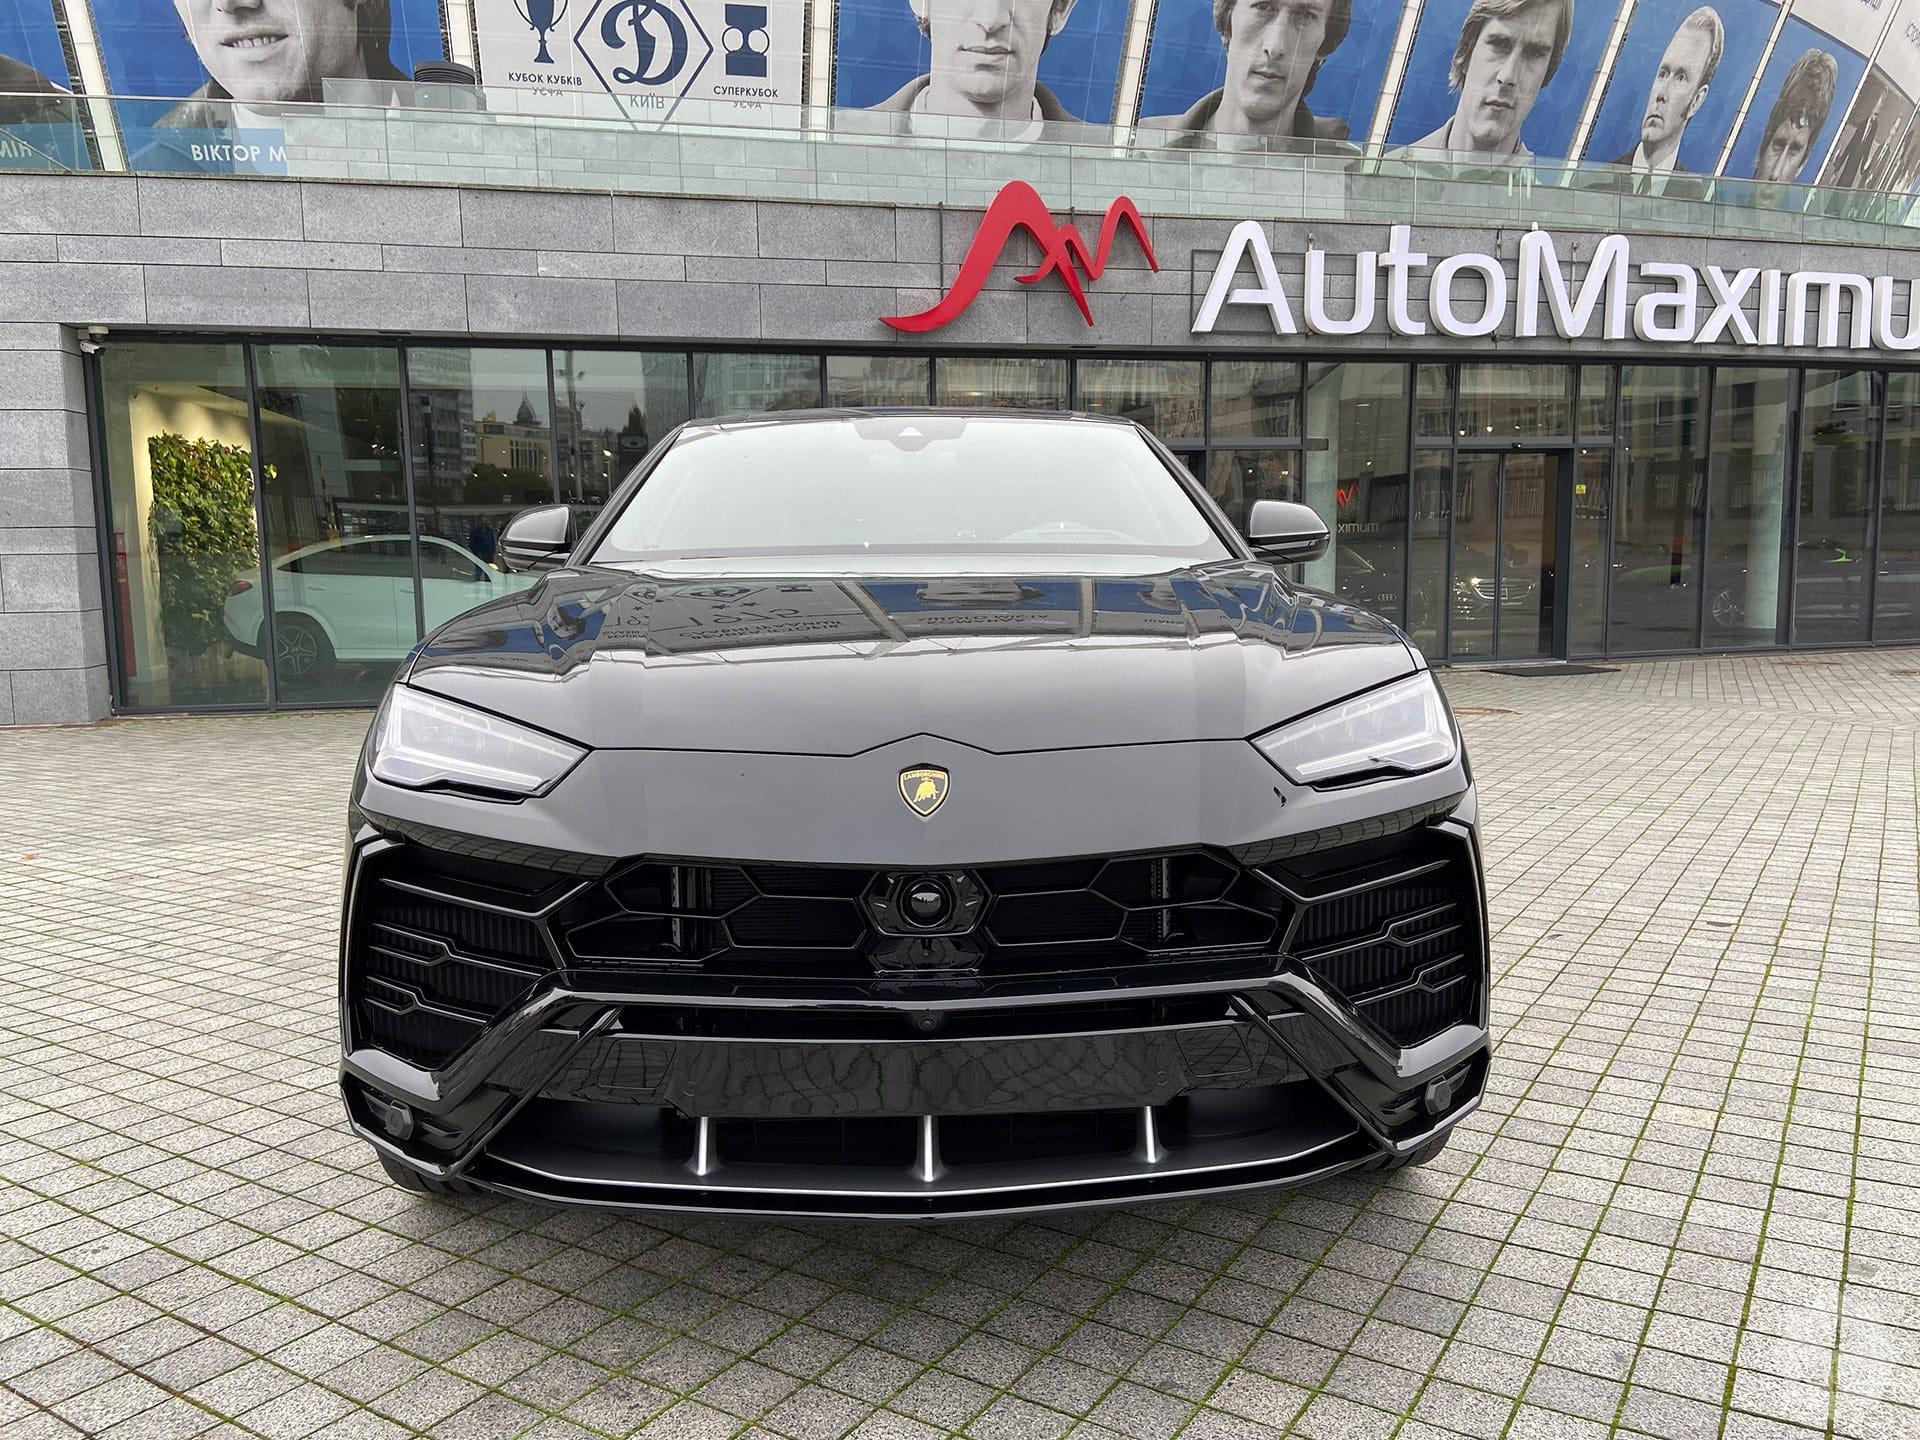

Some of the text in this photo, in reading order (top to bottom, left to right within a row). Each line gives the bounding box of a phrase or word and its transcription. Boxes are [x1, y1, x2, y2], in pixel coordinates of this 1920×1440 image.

[508, 72, 583, 86] КУБОК КУБКІВ
[713, 85, 779, 98] СУПЕРКУБОК
[630, 92, 665, 109] КИЇВ
[190, 144, 261, 162] ВІКТОР
[1191, 220, 1920, 350] AutoMaximu
